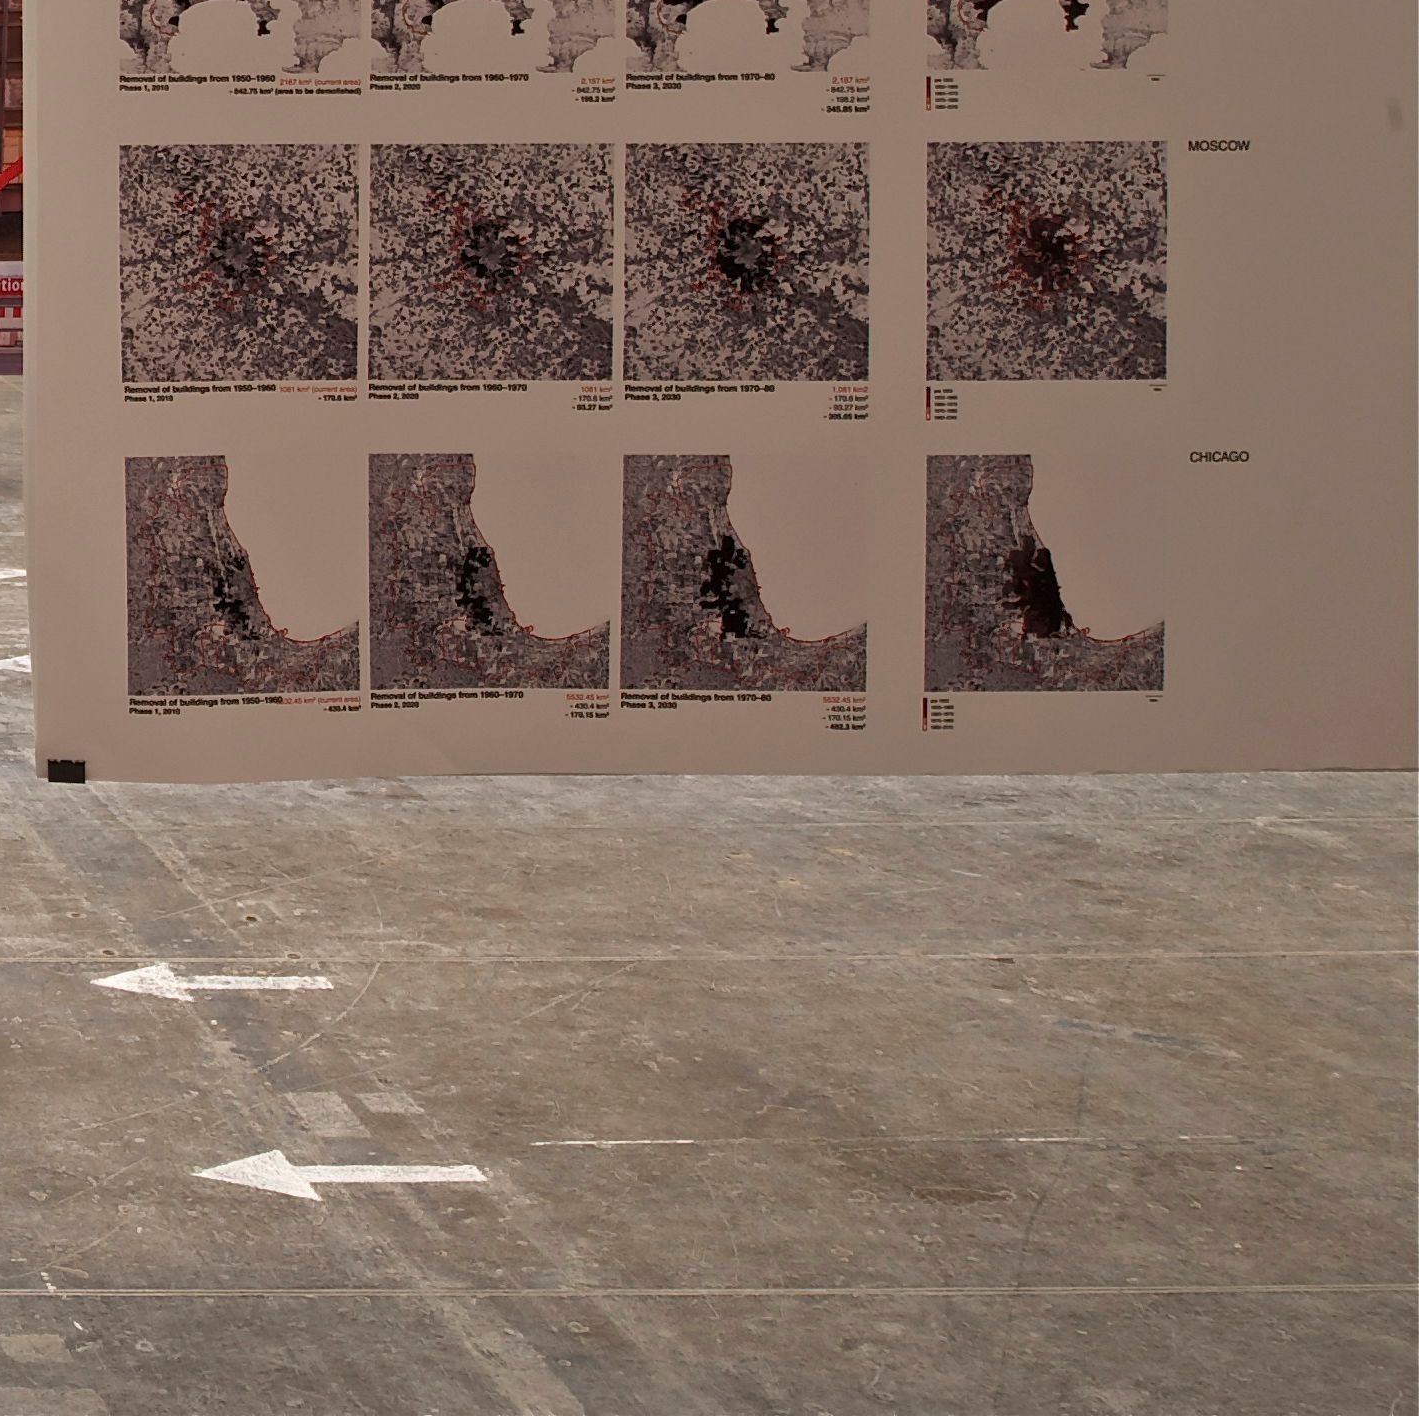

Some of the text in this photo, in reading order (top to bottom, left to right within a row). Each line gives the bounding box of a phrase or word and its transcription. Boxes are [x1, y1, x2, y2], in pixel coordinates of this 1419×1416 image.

[118, 72, 156, 83] Removal
[158, 74, 166, 83] of
[167, 72, 208, 85] buildings
[209, 74, 230, 83] from
[369, 71, 408, 82] Removal
[408, 73, 419, 82] of
[419, 71, 461, 84] buildings
[461, 73, 483, 82] from
[625, 71, 664, 82] Removal
[664, 73, 675, 82] of
[675, 72, 717, 83] buildings
[717, 72, 739, 82] from
[118, 84, 143, 92] Phase
[369, 83, 394, 91] Phase
[625, 82, 652, 90] Phase
[1188, 140, 1250, 151] MOSCOW
[123, 385, 161, 394] Removal
[162, 385, 170, 394] of
[171, 385, 211, 395] buildings
[211, 384, 232, 393] from
[368, 383, 406, 392] Removal
[406, 383, 417, 392] of
[417, 383, 459, 394] buildings
[459, 383, 481, 392] from
[624, 384, 663, 395] Removal
[663, 384, 674, 393] of
[674, 384, 716, 395] buildings
[716, 384, 738, 393] from
[123, 395, 148, 403] Phase
[367, 392, 392, 400] Phase
[624, 392, 651, 401] Phase
[1190, 451, 1249, 463] CHICAGO
[370, 691, 406, 701] Removal
[408, 691, 416, 700] of
[417, 691, 458, 702] buildings
[457, 690, 479, 699] from
[620, 692, 659, 703] Removal
[659, 692, 670, 701] of
[670, 692, 713, 703] buildings
[713, 693, 735, 702] from
[128, 697, 167, 707] Removal
[169, 698, 177, 707] of
[178, 697, 219, 708] buildings
[219, 697, 240, 706] from
[370, 701, 393, 709] Phase
[620, 700, 647, 709] Phase
[128, 707, 154, 715] Phase
